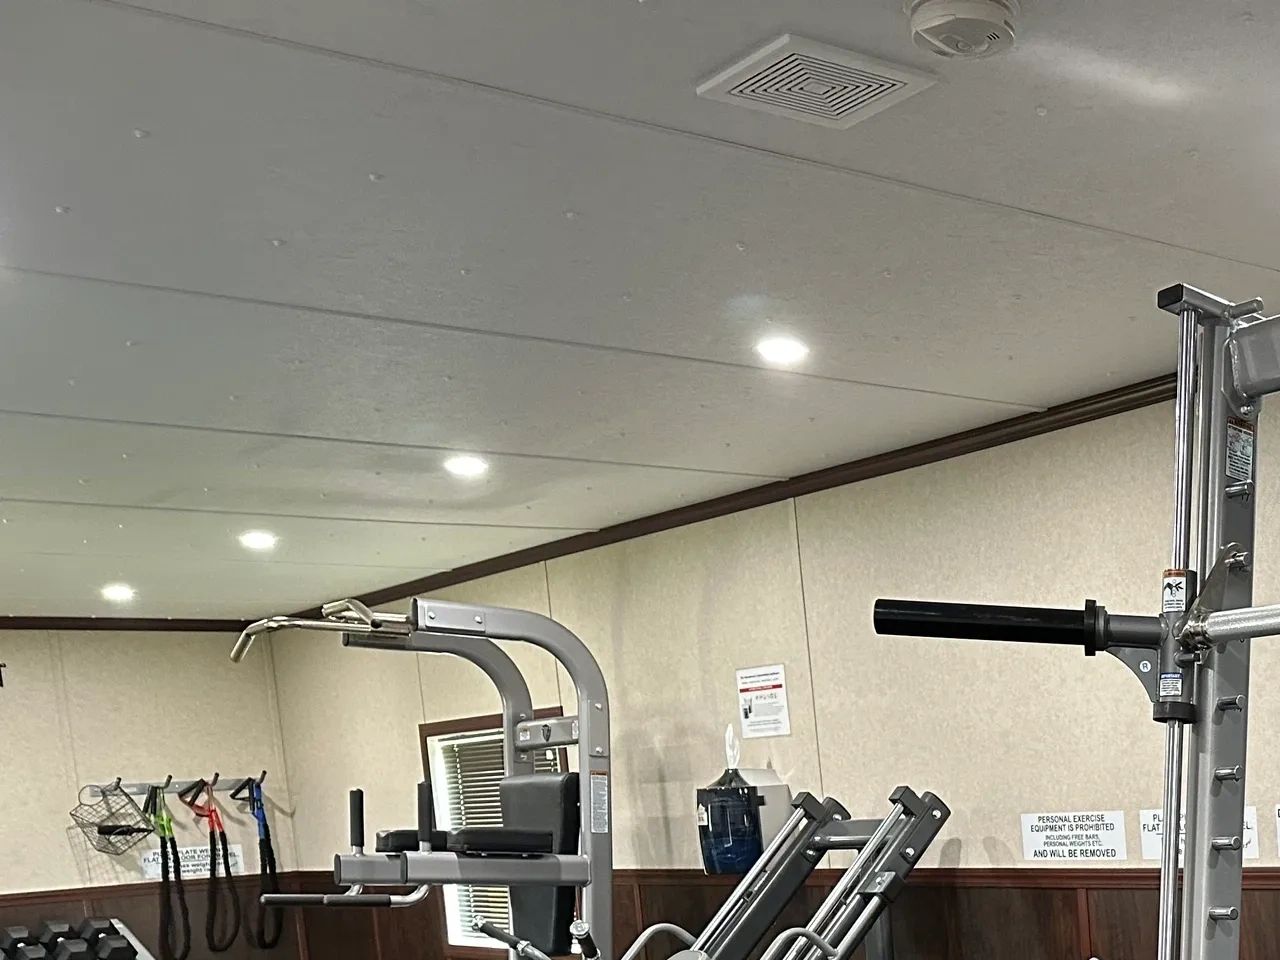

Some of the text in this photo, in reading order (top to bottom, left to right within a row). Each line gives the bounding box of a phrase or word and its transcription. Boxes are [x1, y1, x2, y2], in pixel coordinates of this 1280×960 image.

[1142, 662, 1149, 670] R
[1073, 814, 1105, 823] EXERCISE
[1031, 824, 1066, 832] EQUIPMENT
[1076, 823, 1114, 831] PROHIBITED
[1143, 824, 1160, 832] FLAT
[1034, 850, 1048, 858] AND
[1080, 849, 1116, 857] REMOVED
